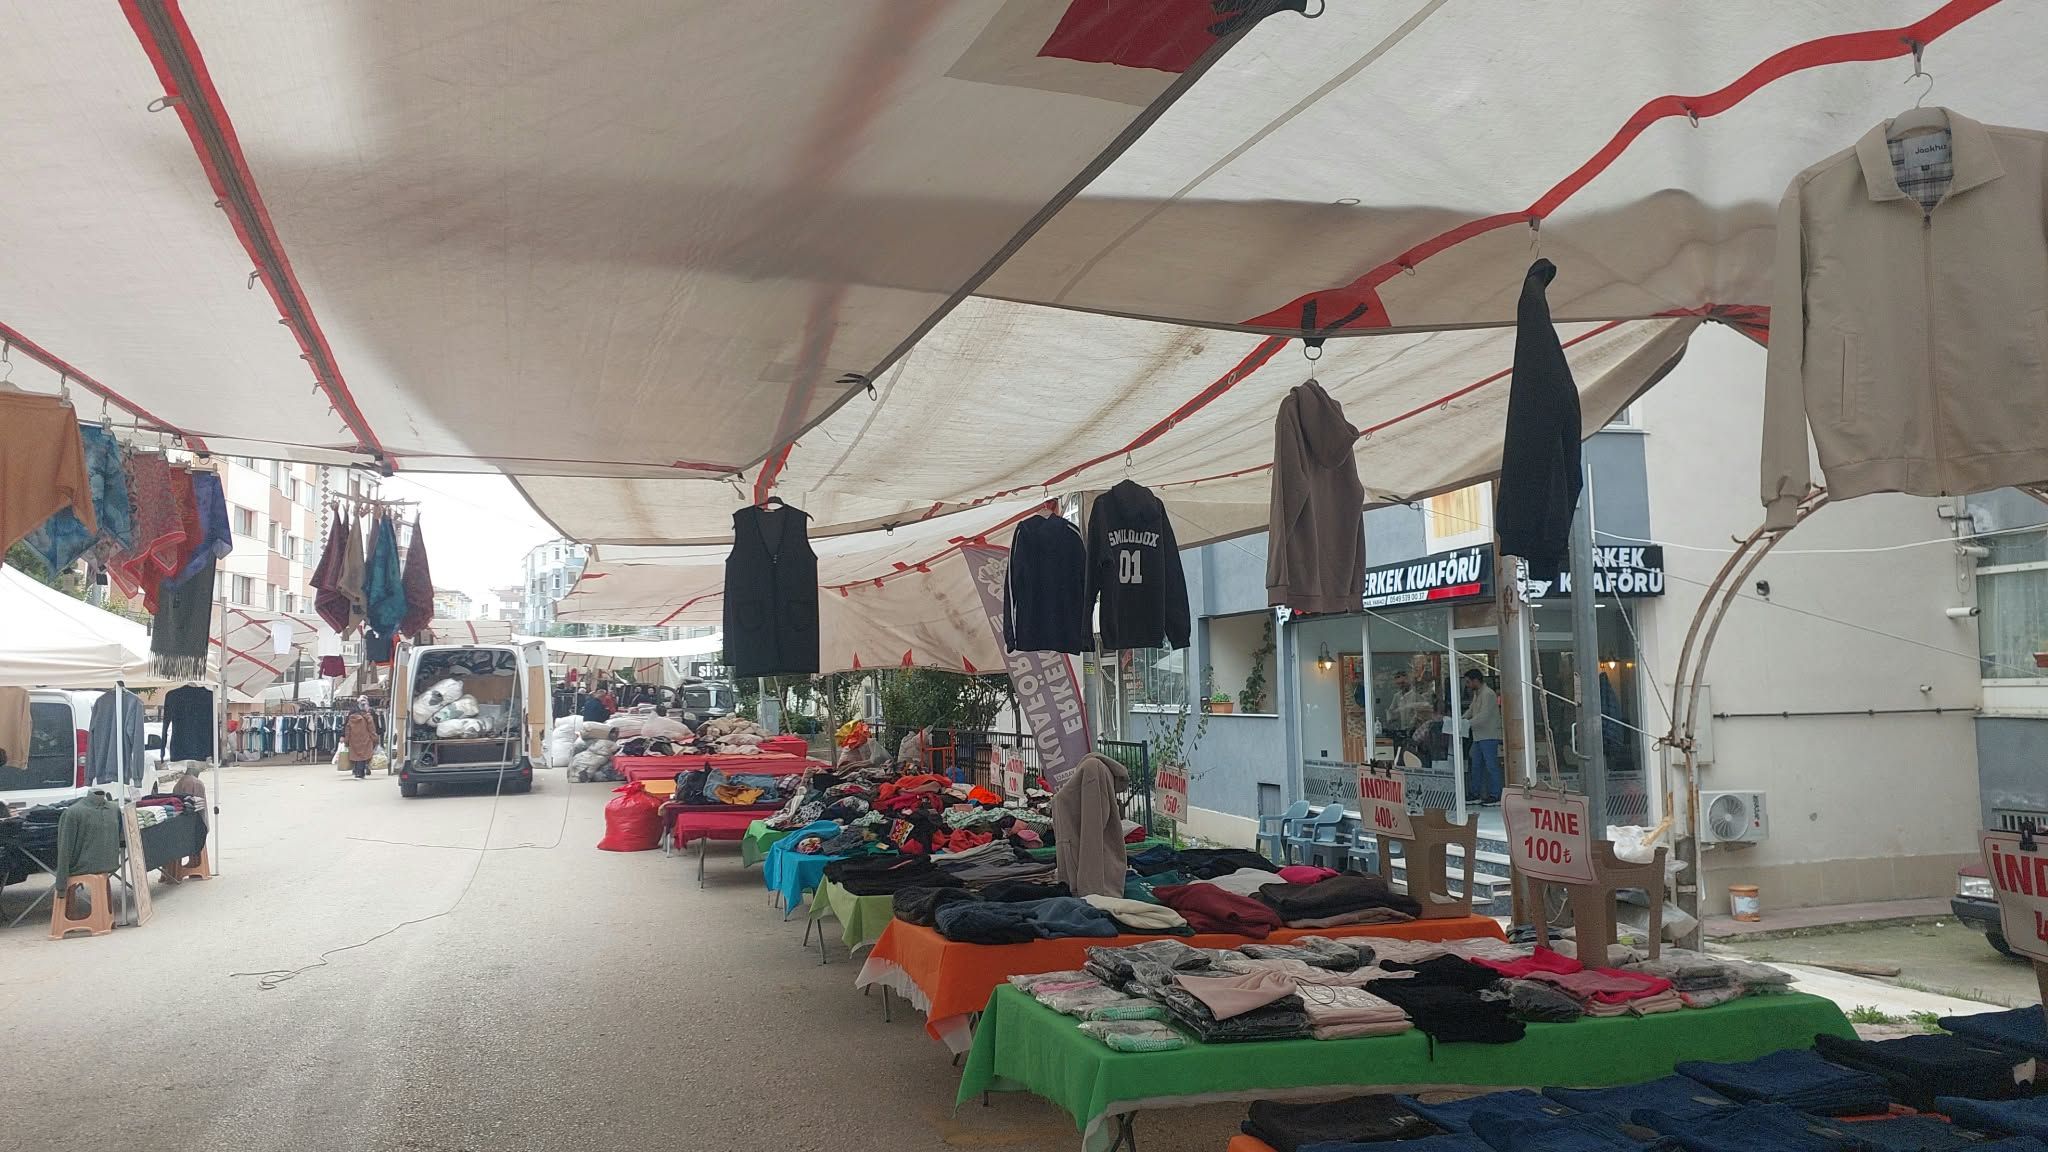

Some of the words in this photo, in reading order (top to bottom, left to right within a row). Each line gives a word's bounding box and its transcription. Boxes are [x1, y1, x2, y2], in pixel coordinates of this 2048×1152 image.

[1119, 549, 1143, 584] 01
[1406, 548, 1482, 591] KUAFÖRÜ
[1560, 567, 1664, 593] KAFÖRÜ
[1530, 807, 1580, 836] TANE
[1524, 835, 1572, 865] 100₺
